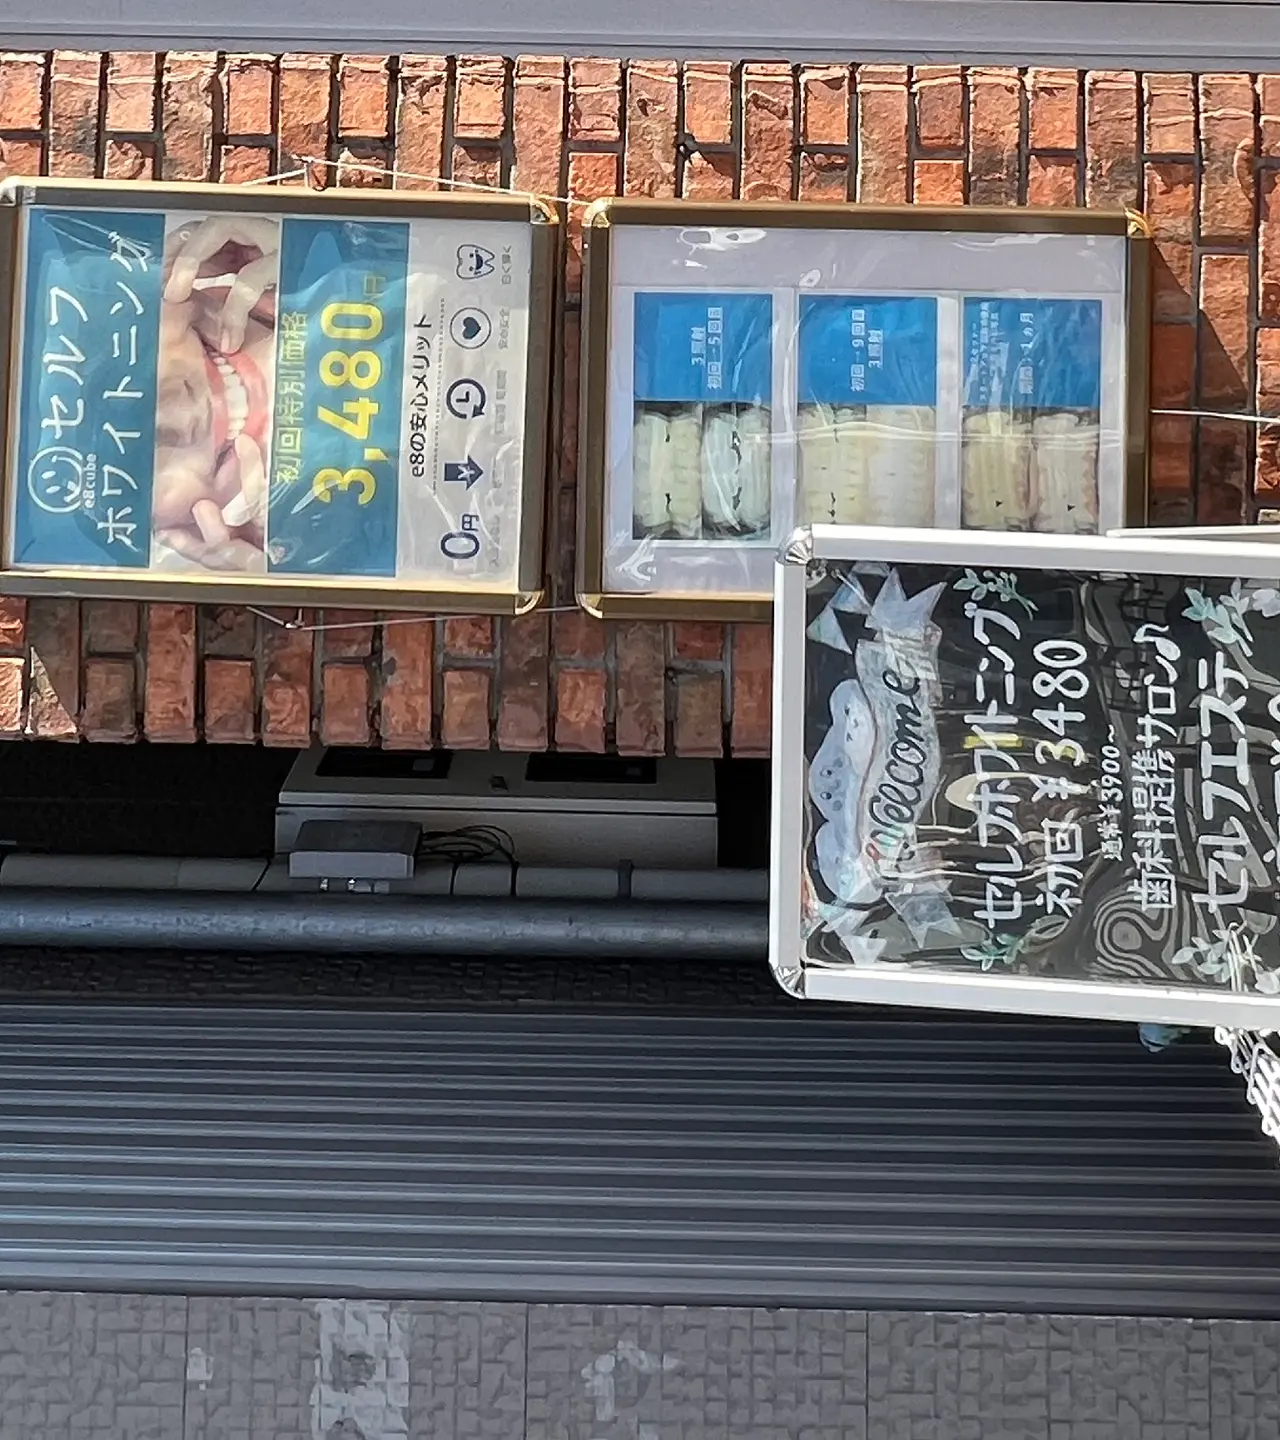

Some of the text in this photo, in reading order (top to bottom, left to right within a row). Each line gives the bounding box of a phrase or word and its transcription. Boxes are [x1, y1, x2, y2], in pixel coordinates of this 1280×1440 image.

[40, 285, 90, 439] セルフ
[96, 230, 152, 544] ホワイトニング
[276, 310, 309, 483] 初回特別価格
[409, 313, 432, 478] e8の安心メリット
[865, 668, 927, 872] Welcome
[963, 601, 1024, 928] セルフホワイトニング
[1192, 651, 1250, 914] セルフエステ
